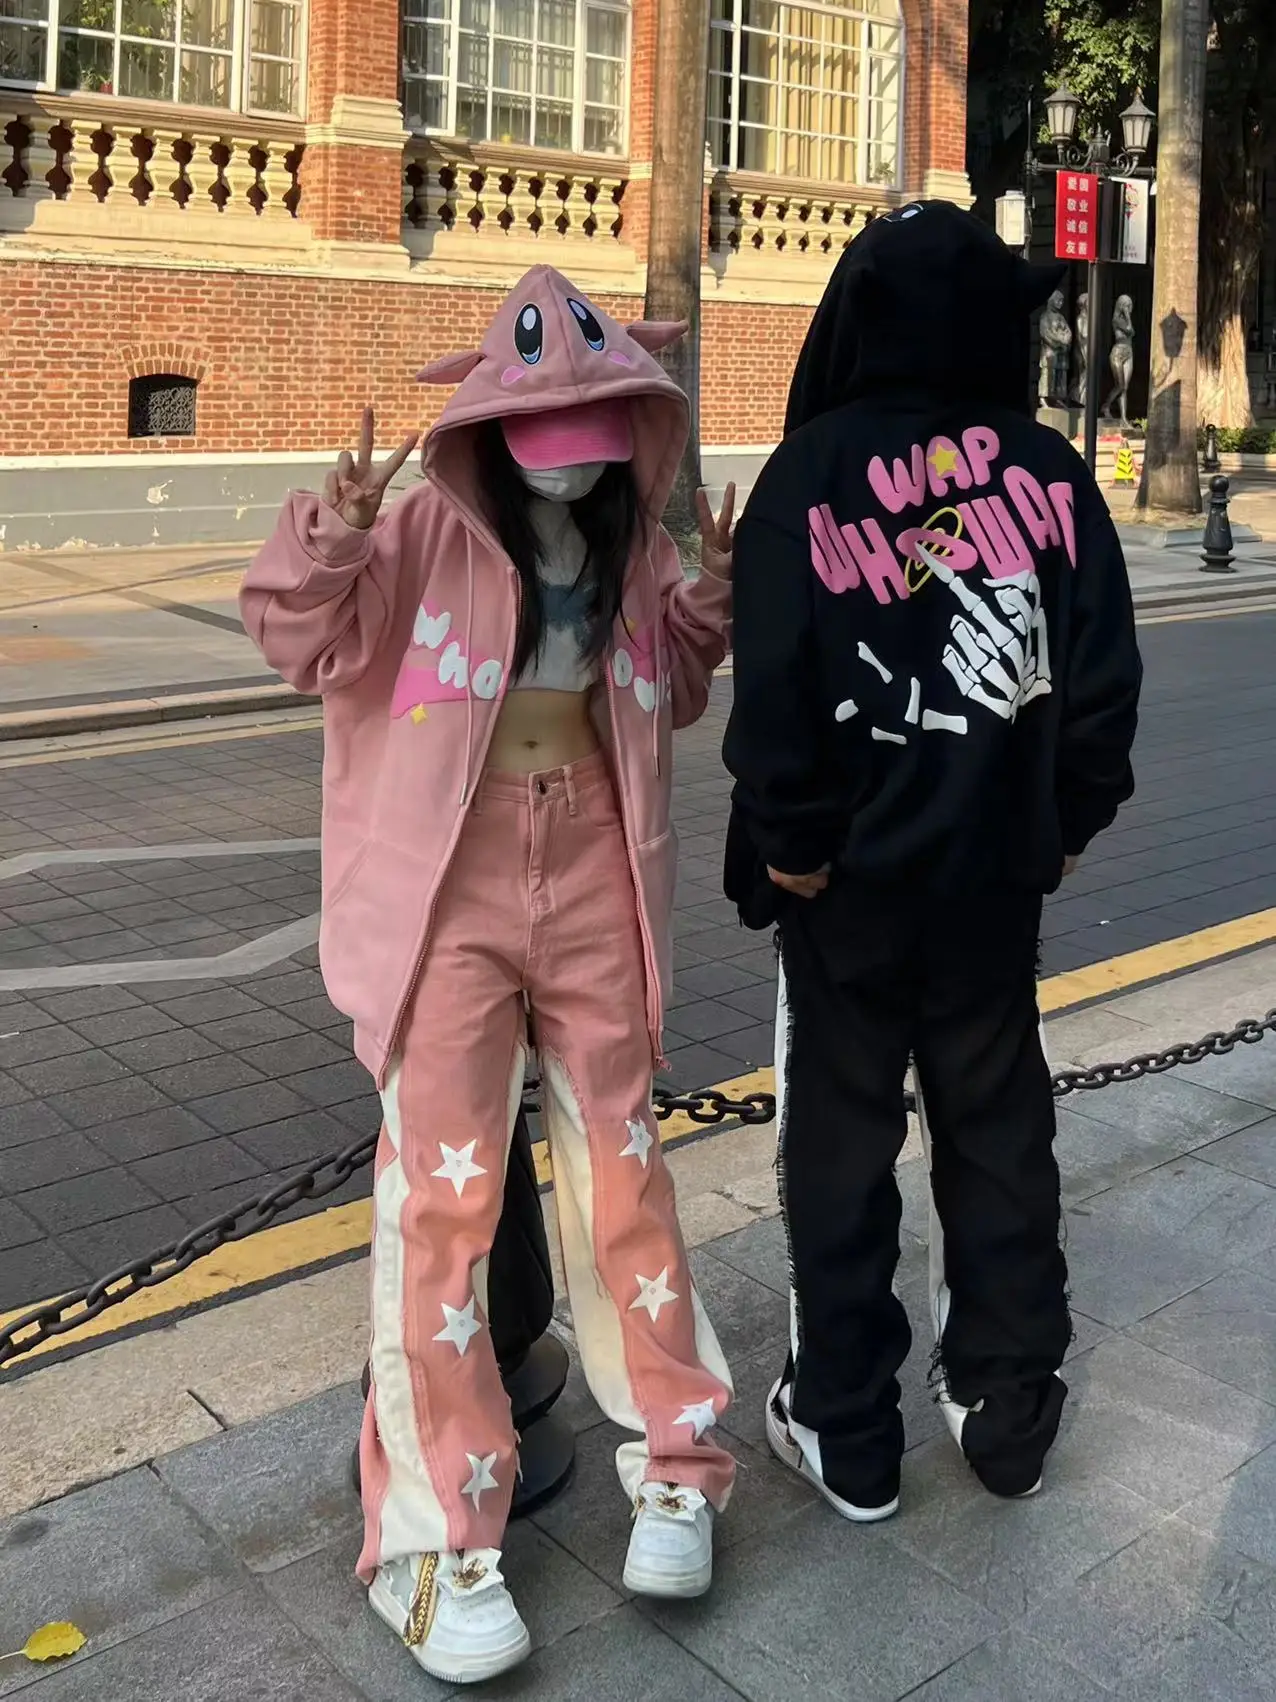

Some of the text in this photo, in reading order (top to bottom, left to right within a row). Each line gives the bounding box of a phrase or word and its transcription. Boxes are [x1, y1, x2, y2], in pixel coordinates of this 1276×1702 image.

[1067, 176, 1089, 192] 爱国
[1066, 198, 1089, 213] 敬业
[1066, 219, 1088, 234] 诚信
[1065, 240, 1088, 255] 友善
[867, 426, 1000, 514] WAP
